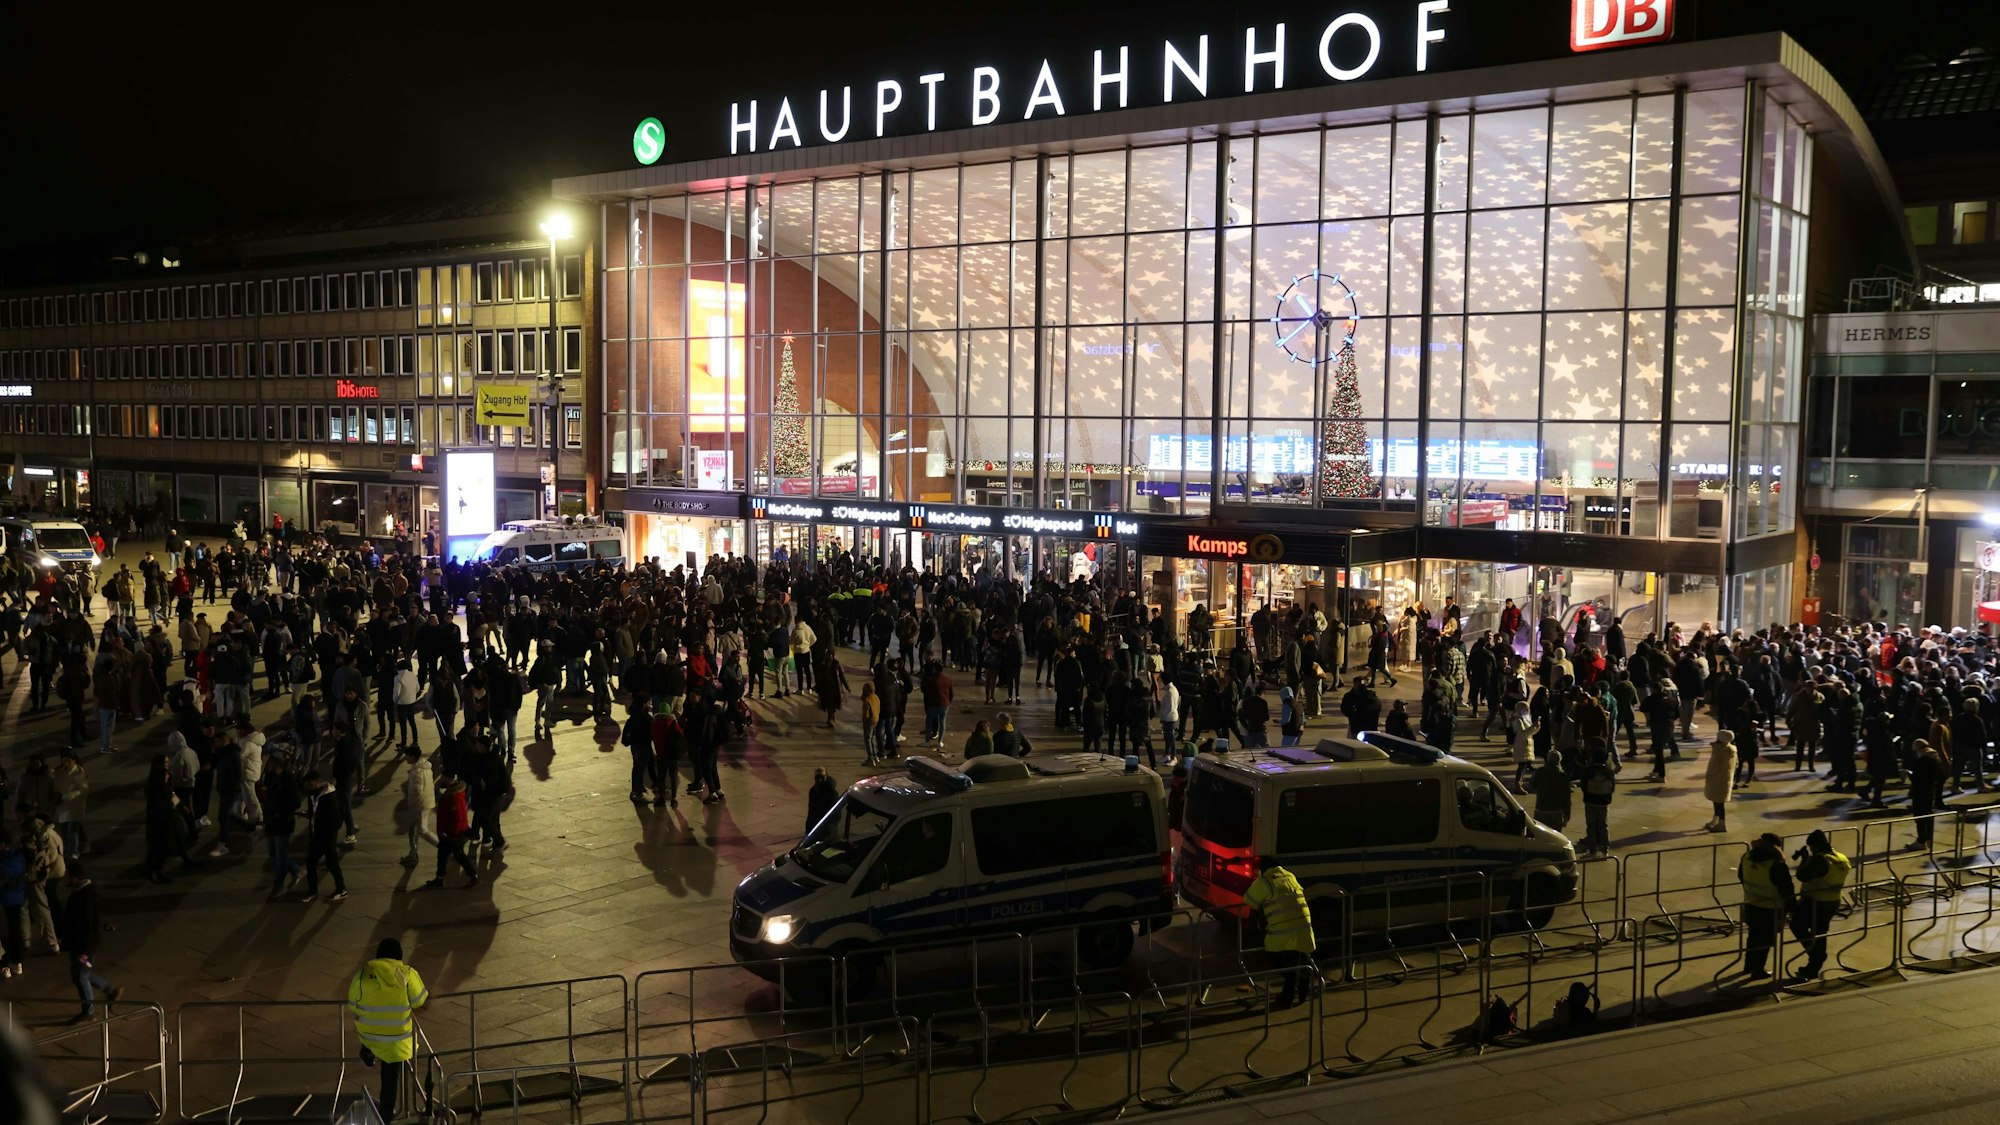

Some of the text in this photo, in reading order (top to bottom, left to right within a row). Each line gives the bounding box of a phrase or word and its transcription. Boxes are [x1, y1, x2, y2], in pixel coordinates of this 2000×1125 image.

[1584, 0, 1658, 39] DB
[731, 0, 1449, 154] HAUPTBAHNHOF
[638, 122, 660, 160] S
[9, 385, 33, 397] COFFEE
[337, 379, 379, 398] ibis HOTEL
[484, 394, 527, 406] Zugang Hbf
[662, 502, 709, 511] THE BODY SHOP
[768, 503, 901, 523] NetCologne Highspeed
[928, 512, 1083, 532] NetCologne Highspeed
[1187, 534, 1248, 558] Kamps
[992, 899, 1044, 918] POLIZEI
